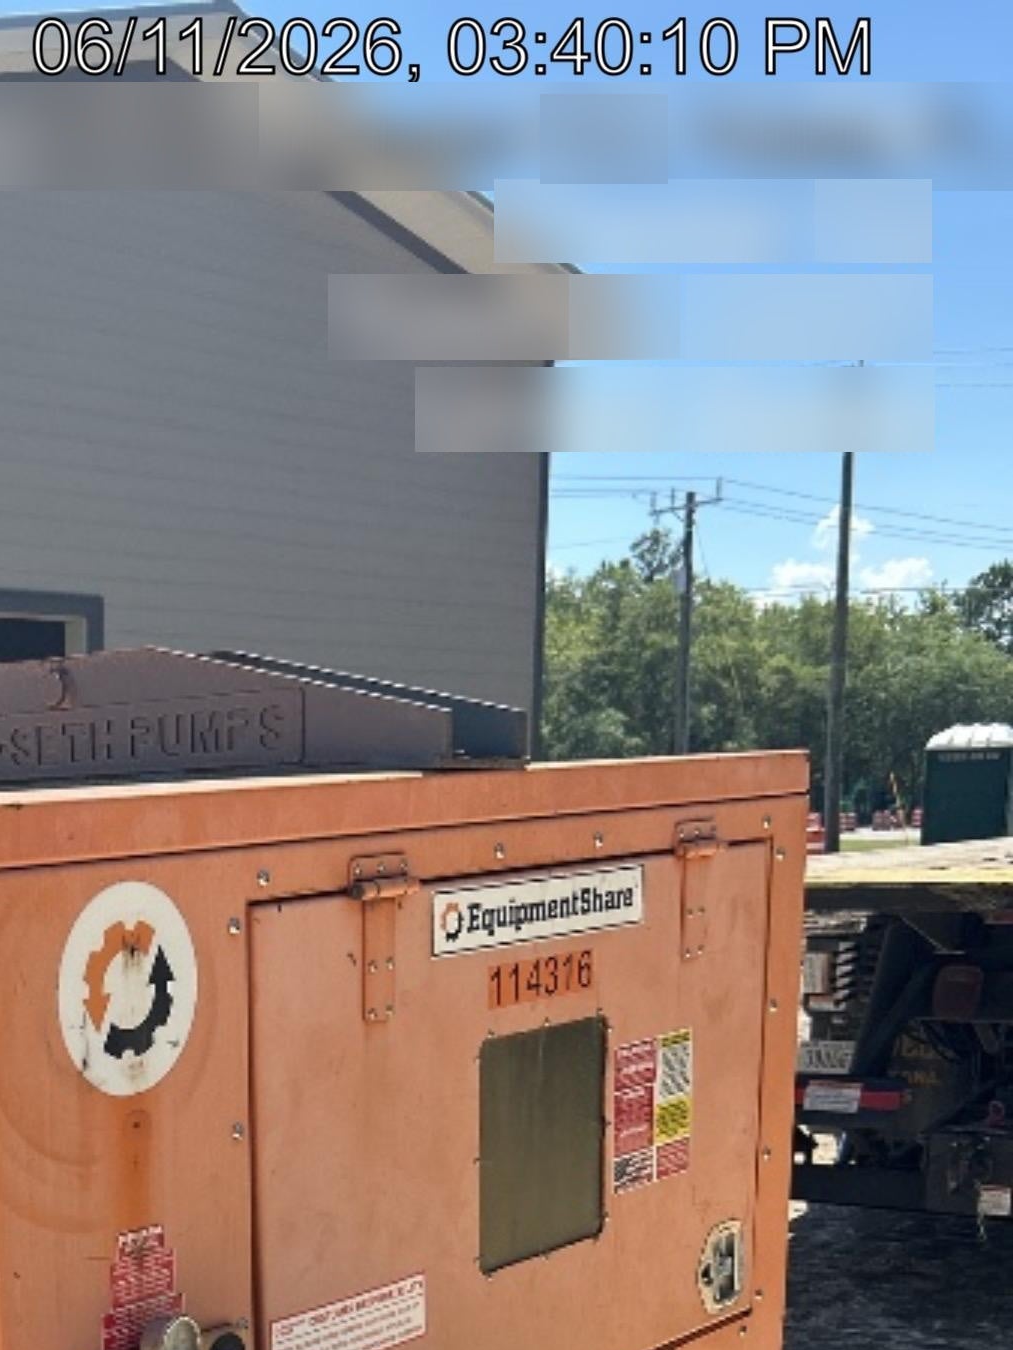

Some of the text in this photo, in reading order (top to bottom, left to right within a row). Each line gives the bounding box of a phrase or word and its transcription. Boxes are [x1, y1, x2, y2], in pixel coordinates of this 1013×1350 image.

[129, 703, 285, 758] PUMPS
[467, 886, 634, 935] EquipmentShare
[490, 950, 593, 1006] 114316
